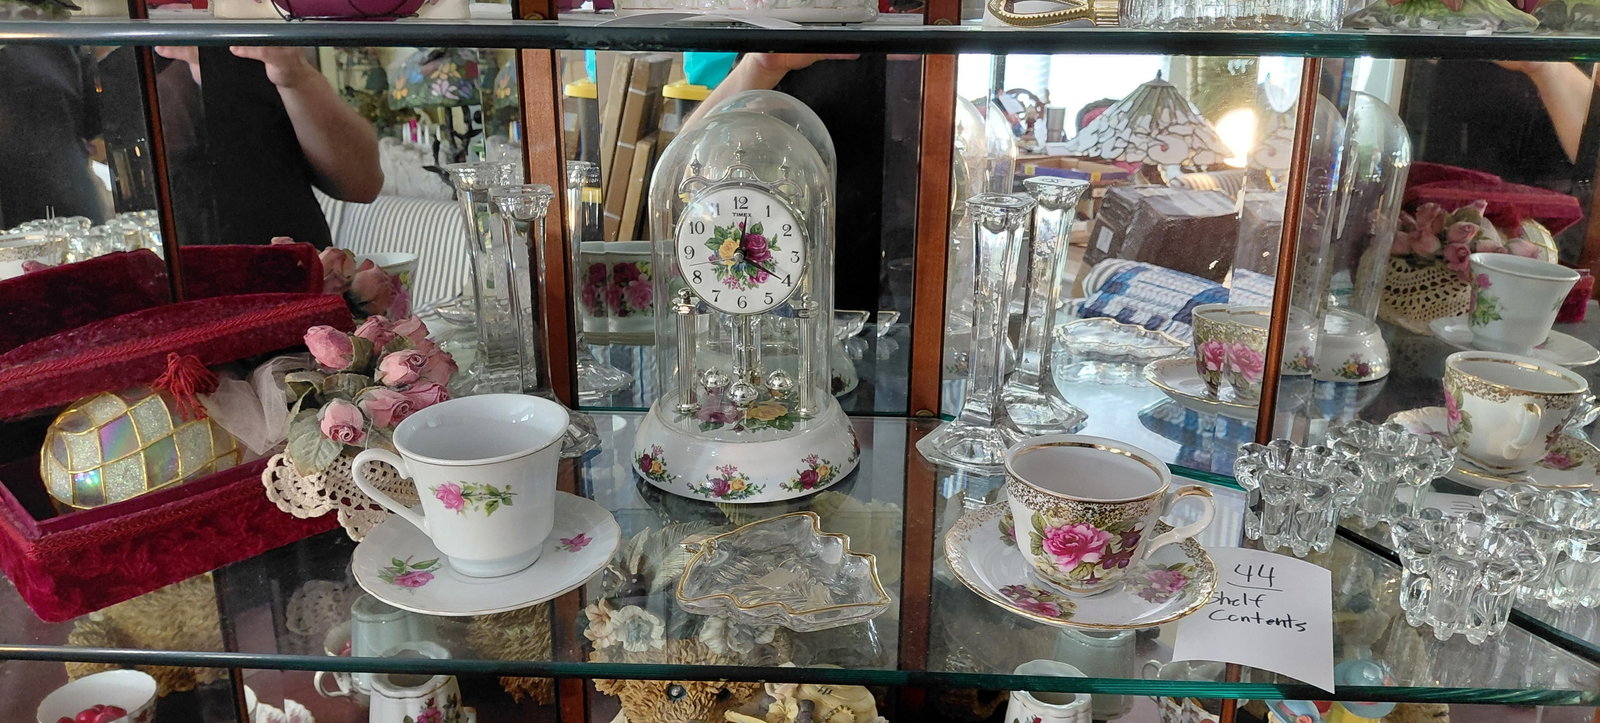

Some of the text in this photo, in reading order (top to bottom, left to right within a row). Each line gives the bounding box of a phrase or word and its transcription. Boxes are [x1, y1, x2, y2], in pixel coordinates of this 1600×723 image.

[733, 196, 749, 210] 12
[765, 204, 771, 218] 1
[689, 221, 705, 235] 10
[782, 223, 792, 237] 2
[683, 245, 695, 260] 9
[790, 250, 800, 264] 3
[692, 270, 703, 285] 8
[781, 274, 793, 287] 4
[711, 289, 721, 303] 7
[737, 295, 748, 309] 6
[763, 292, 774, 305] 5
[1234, 564, 1276, 587] 44
[1208, 609, 1307, 632] Contents
